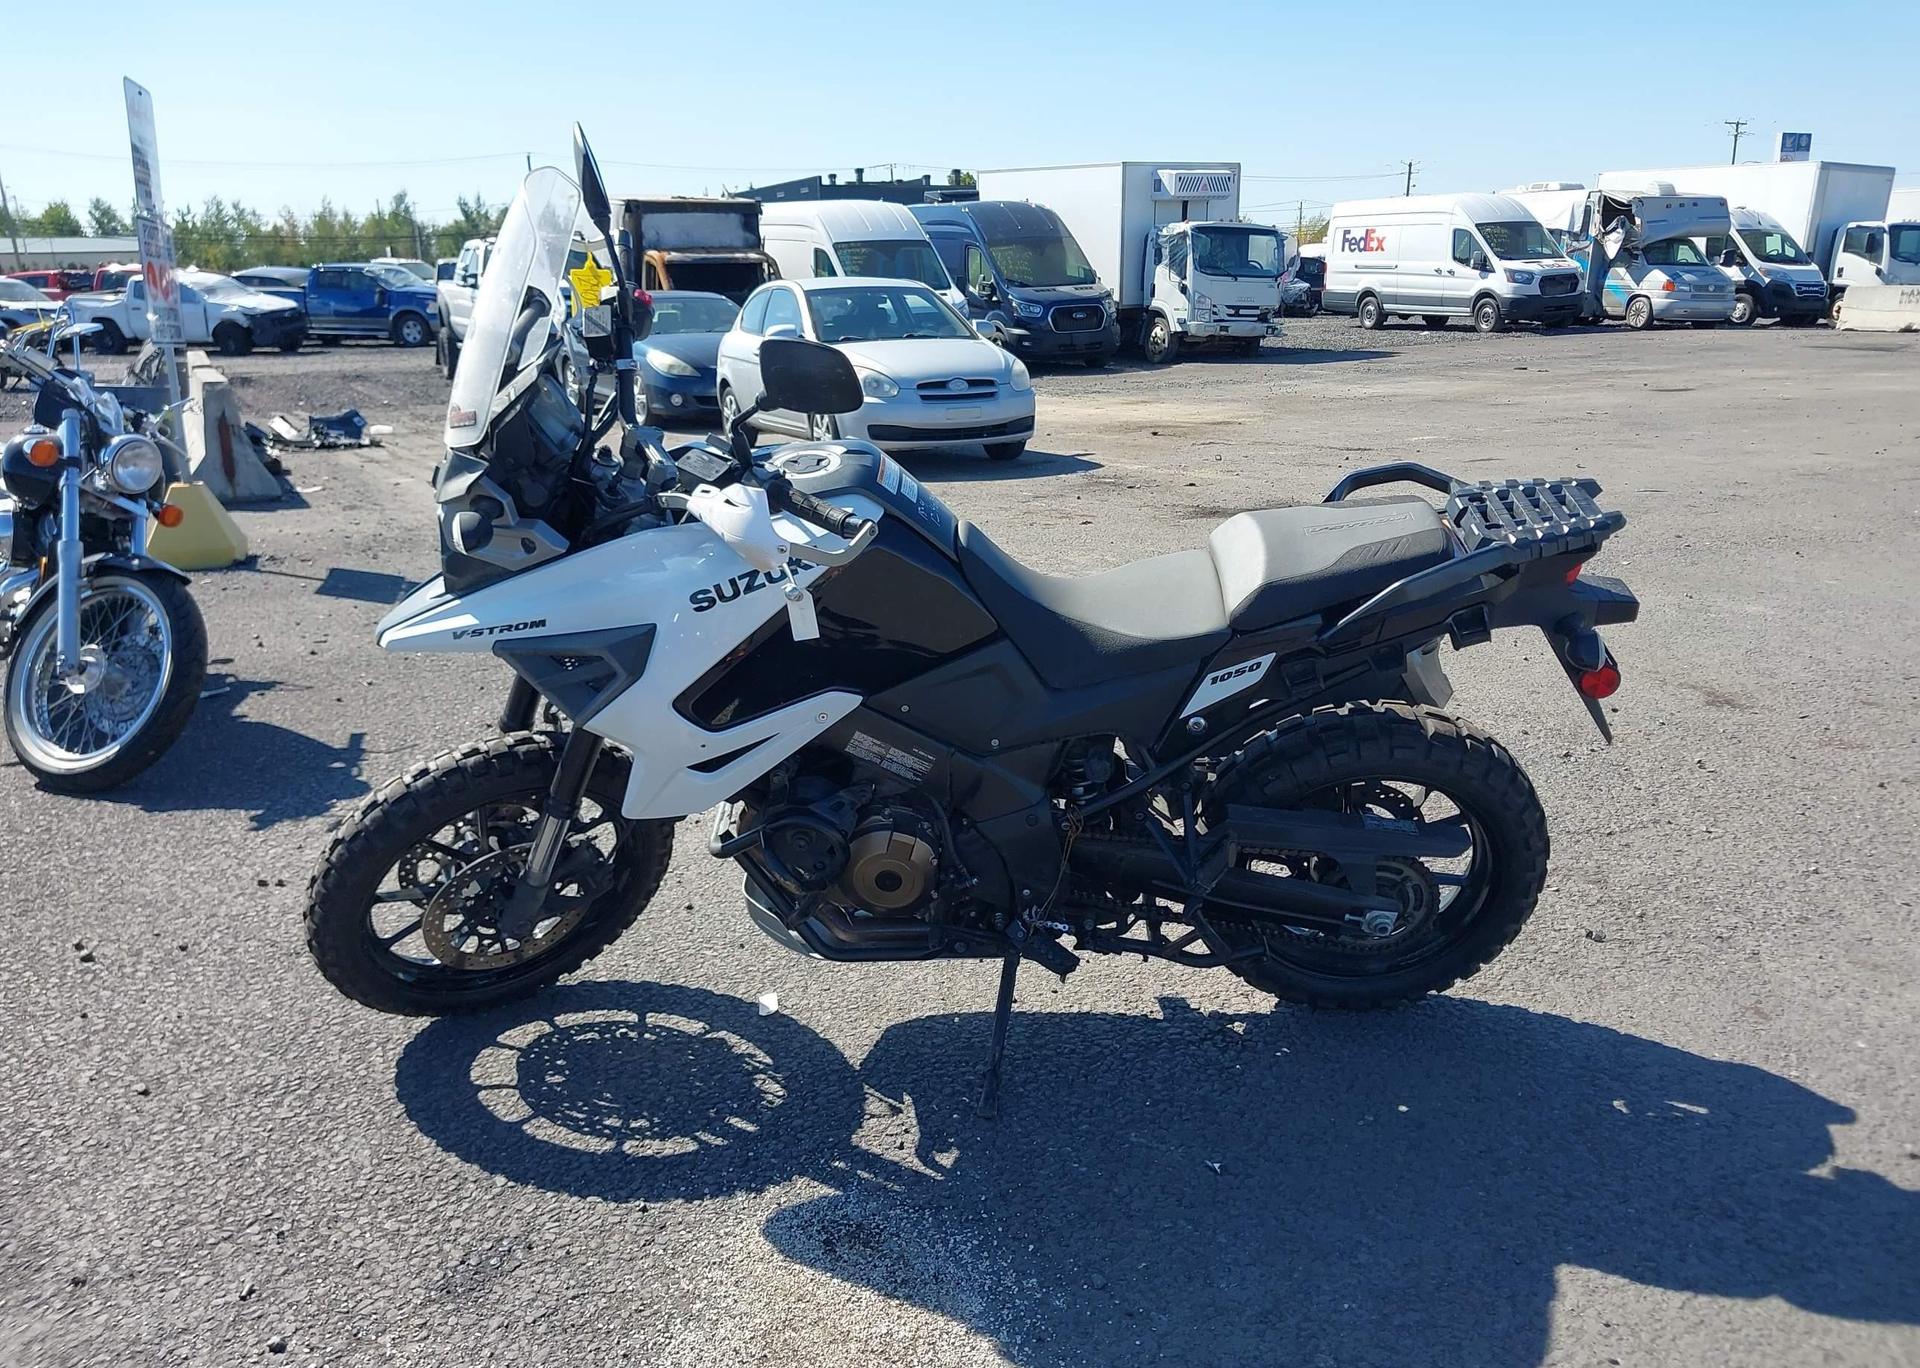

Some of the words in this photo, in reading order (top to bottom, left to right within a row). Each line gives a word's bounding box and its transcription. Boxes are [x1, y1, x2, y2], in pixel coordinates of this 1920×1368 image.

[1341, 229, 1386, 252] FedEx
[689, 556, 820, 612] SUZUK
[452, 619, 547, 640] V-STROM
[1210, 662, 1262, 685] 1050
